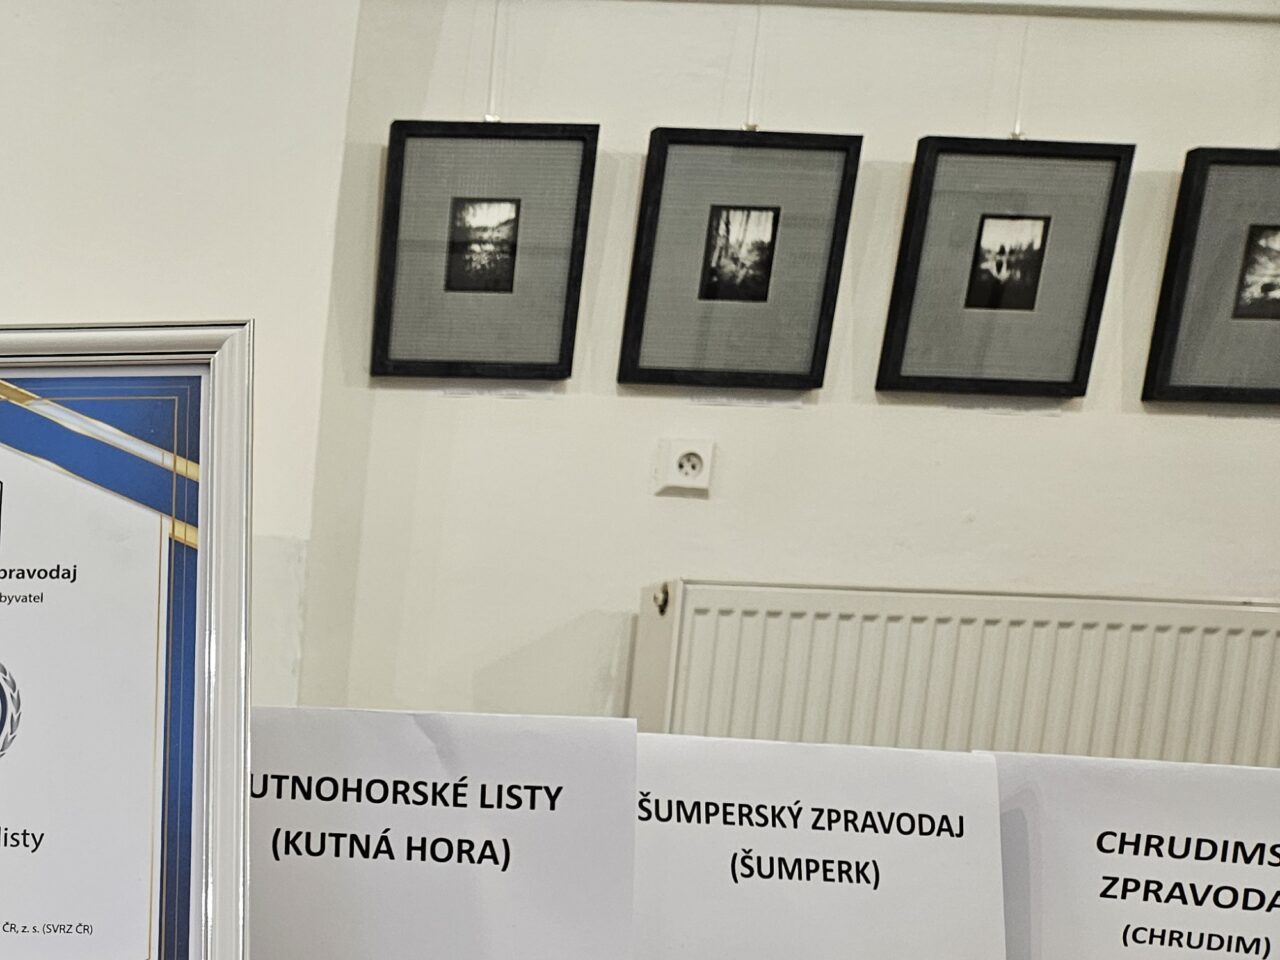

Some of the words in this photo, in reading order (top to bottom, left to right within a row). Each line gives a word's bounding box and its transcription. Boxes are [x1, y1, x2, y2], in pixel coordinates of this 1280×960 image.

[250, 773, 468, 808] UTNOHORSKÉ
[479, 783, 564, 811] LISTY
[637, 791, 803, 829] ŠUMPERSKÝ
[811, 807, 964, 838] ZPRAVODAJ
[271, 828, 395, 861] (KUTNÁ
[406, 836, 511, 872] HORA)
[1096, 830, 1280, 867] CHRUDIMS
[730, 848, 880, 891] (ŠUMPERK)
[1099, 876, 1280, 913] ZPRAVODA
[2, 921, 19, 934] ČR,
[21, 925, 30, 933] z.
[42, 923, 73, 935] (SVRZ
[75, 923, 94, 936] ČR)
[1122, 924, 1271, 960] (CHRUDIM)
